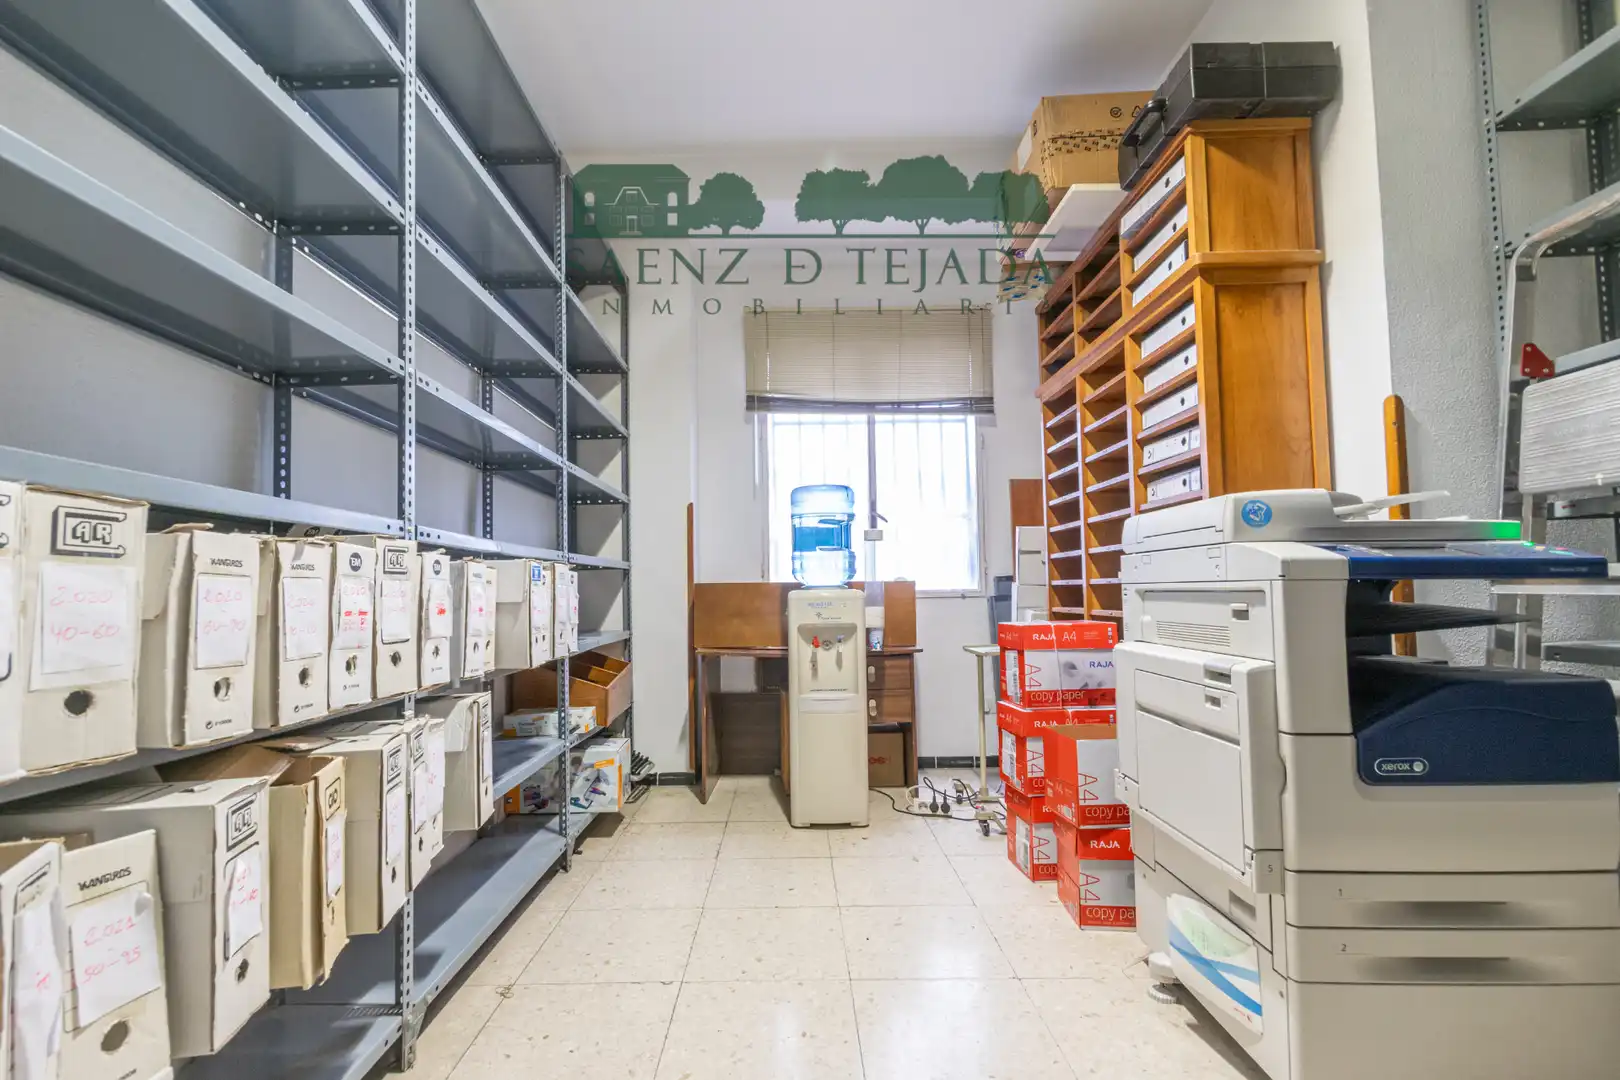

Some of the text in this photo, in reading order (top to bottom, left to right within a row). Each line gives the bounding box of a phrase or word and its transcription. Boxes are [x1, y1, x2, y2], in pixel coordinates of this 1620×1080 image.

[1032, 633, 1056, 641] RAJA
[1062, 630, 1077, 642] A4
[1089, 661, 1115, 669] RAJA
[1025, 663, 1042, 689] A4
[1030, 690, 1086, 703] copy paper
[1026, 749, 1045, 776] A4
[1381, 763, 1411, 771] xerox
[1078, 773, 1099, 803] A4
[1085, 807, 1114, 819] copy
[1033, 836, 1051, 862] A4
[1090, 840, 1121, 849] RAJA
[1039, 865, 1058, 875] cop
[1080, 872, 1101, 903] A4
[1086, 907, 1117, 921] copy
[1340, 943, 1347, 952] 2
